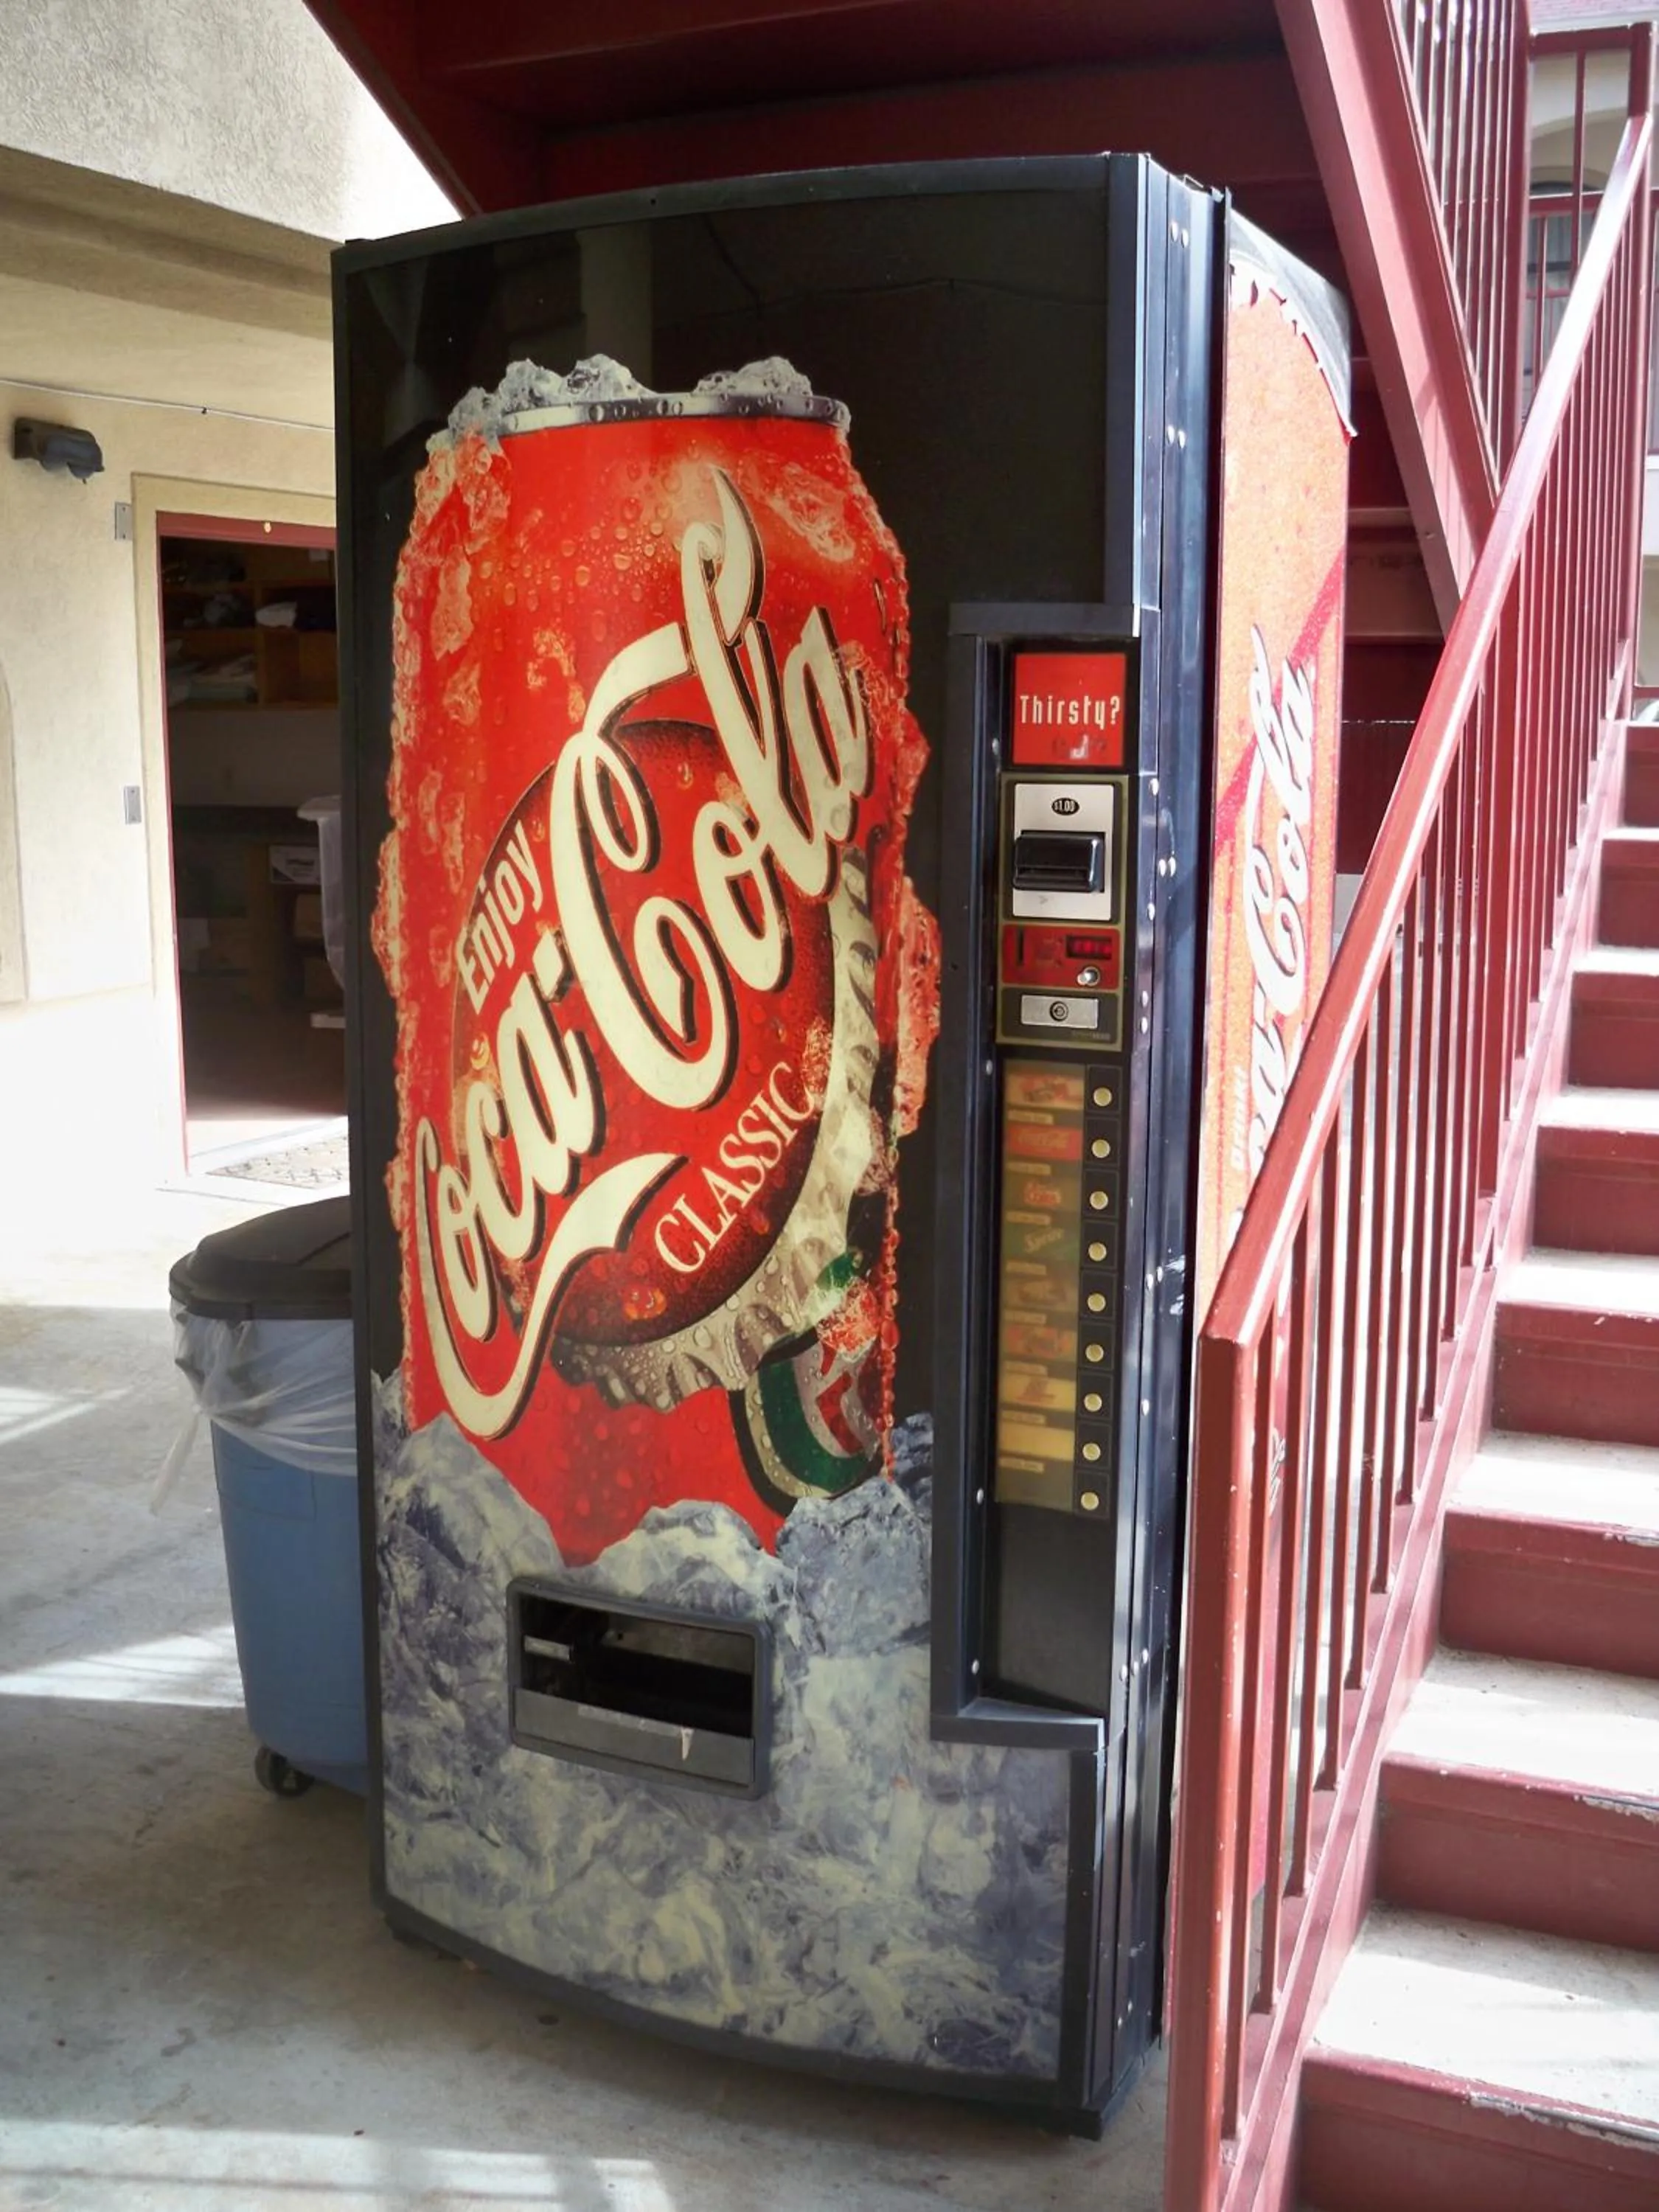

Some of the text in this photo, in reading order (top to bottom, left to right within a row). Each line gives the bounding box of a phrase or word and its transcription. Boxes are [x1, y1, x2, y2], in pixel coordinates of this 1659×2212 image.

[1020, 695, 1121, 730] Thirsty?
[414, 463, 875, 1442] Coca-Cola
[456, 819, 543, 1015] Enjoy
[654, 1061, 815, 1273] CLASSIC
